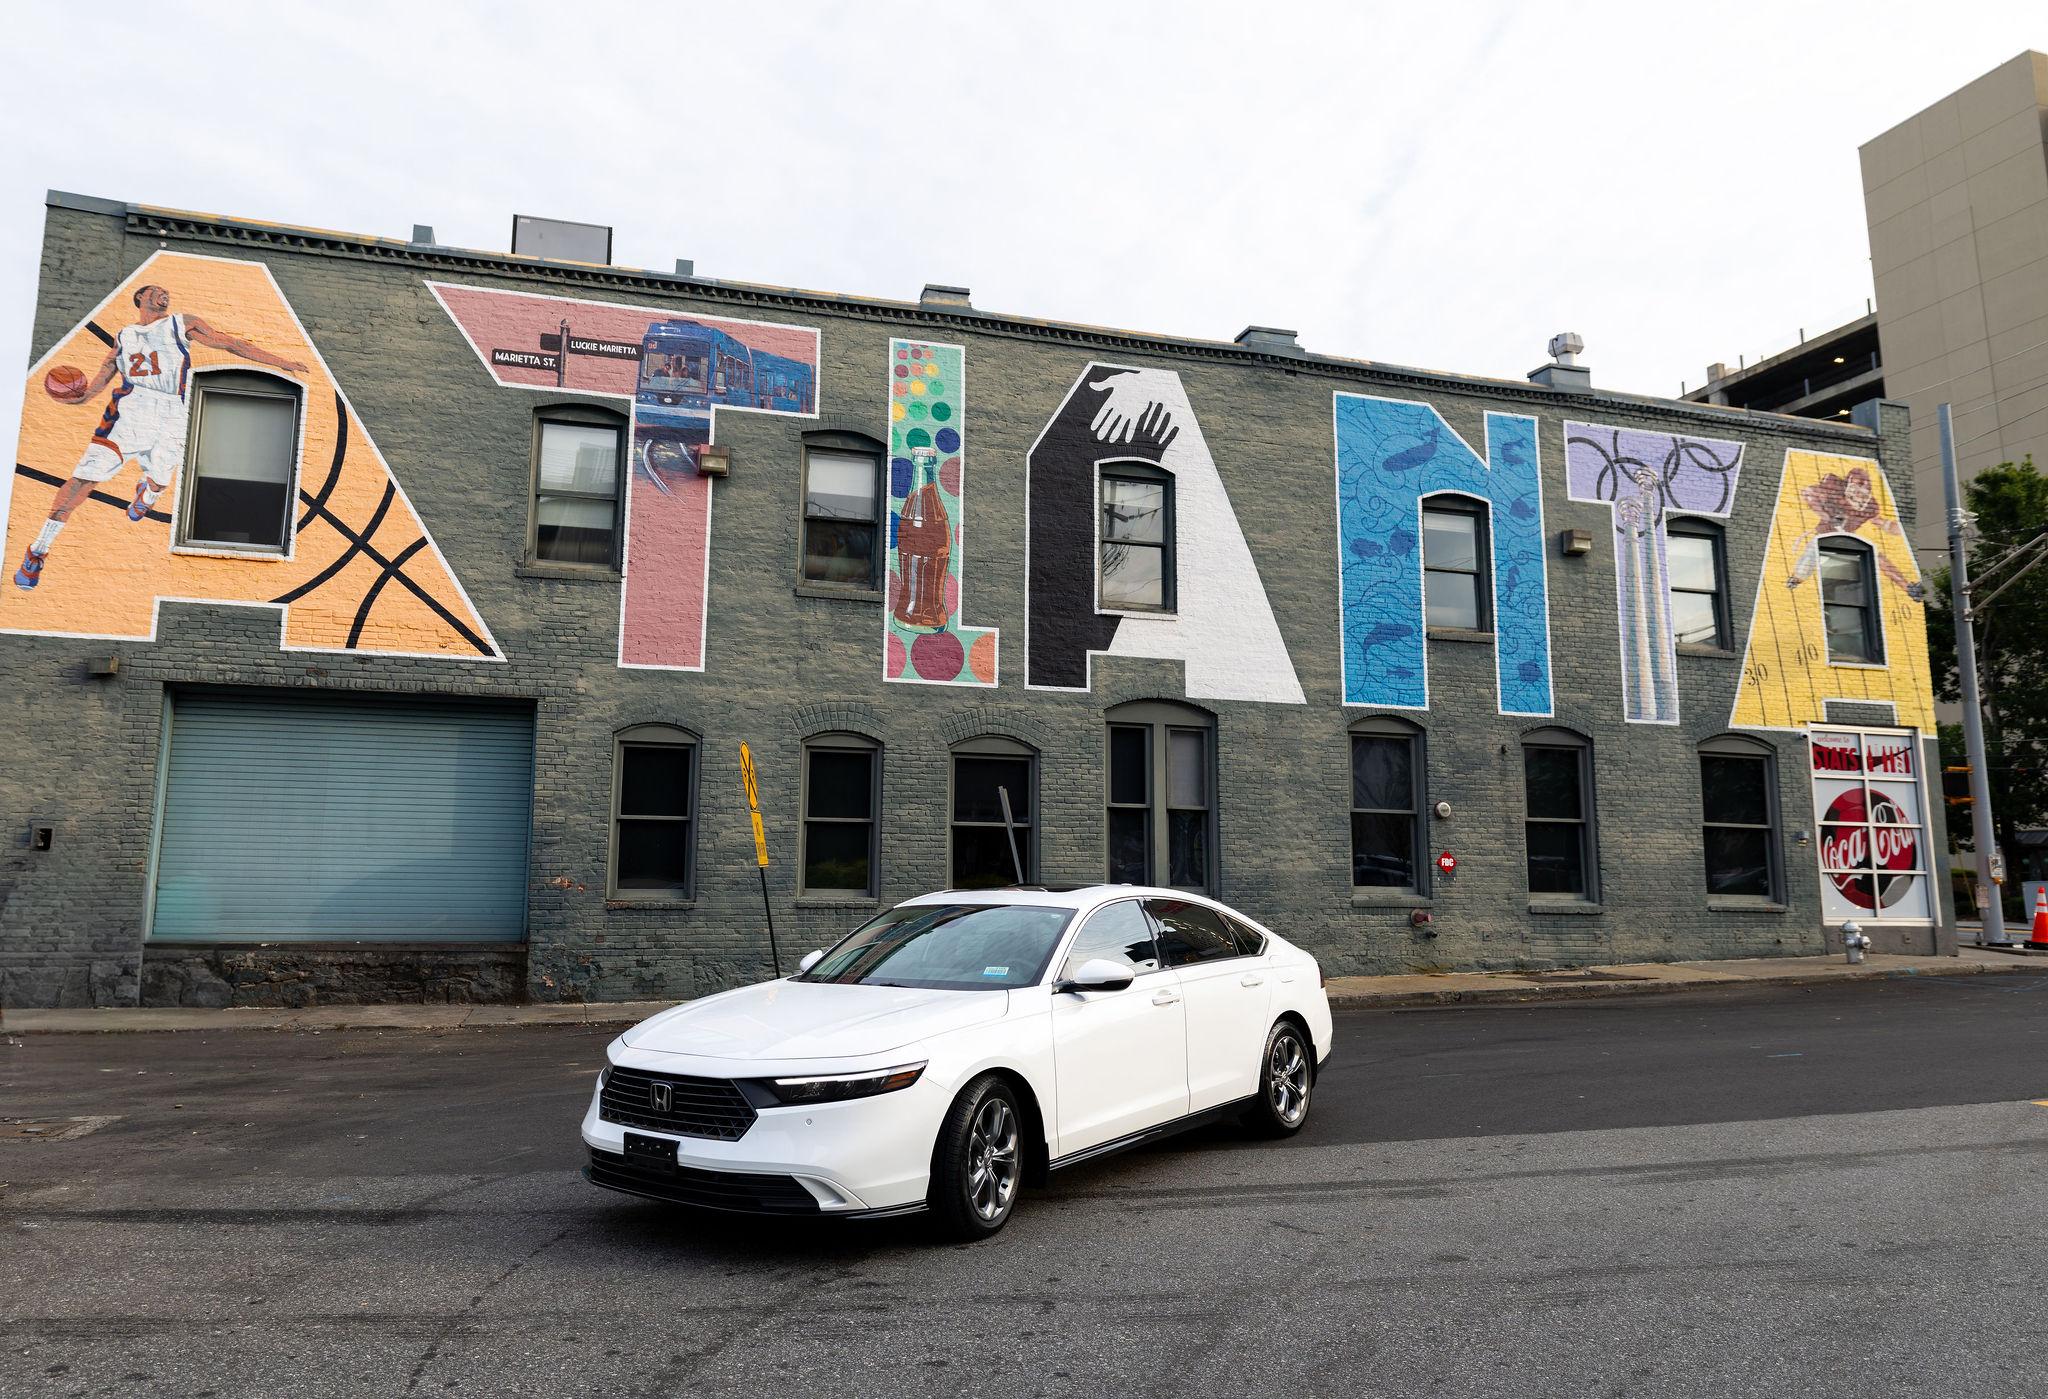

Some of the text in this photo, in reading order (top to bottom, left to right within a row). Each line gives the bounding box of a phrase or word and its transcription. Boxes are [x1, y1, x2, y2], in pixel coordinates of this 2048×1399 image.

[571, 340, 598, 351] LUCKIE
[599, 343, 637, 355] MARIETTA
[128, 350, 162, 377] 21
[495, 352, 556, 367] MARIETTA ST.
[1812, 744, 1859, 771] STATS
[1441, 857, 1454, 867] FDC
